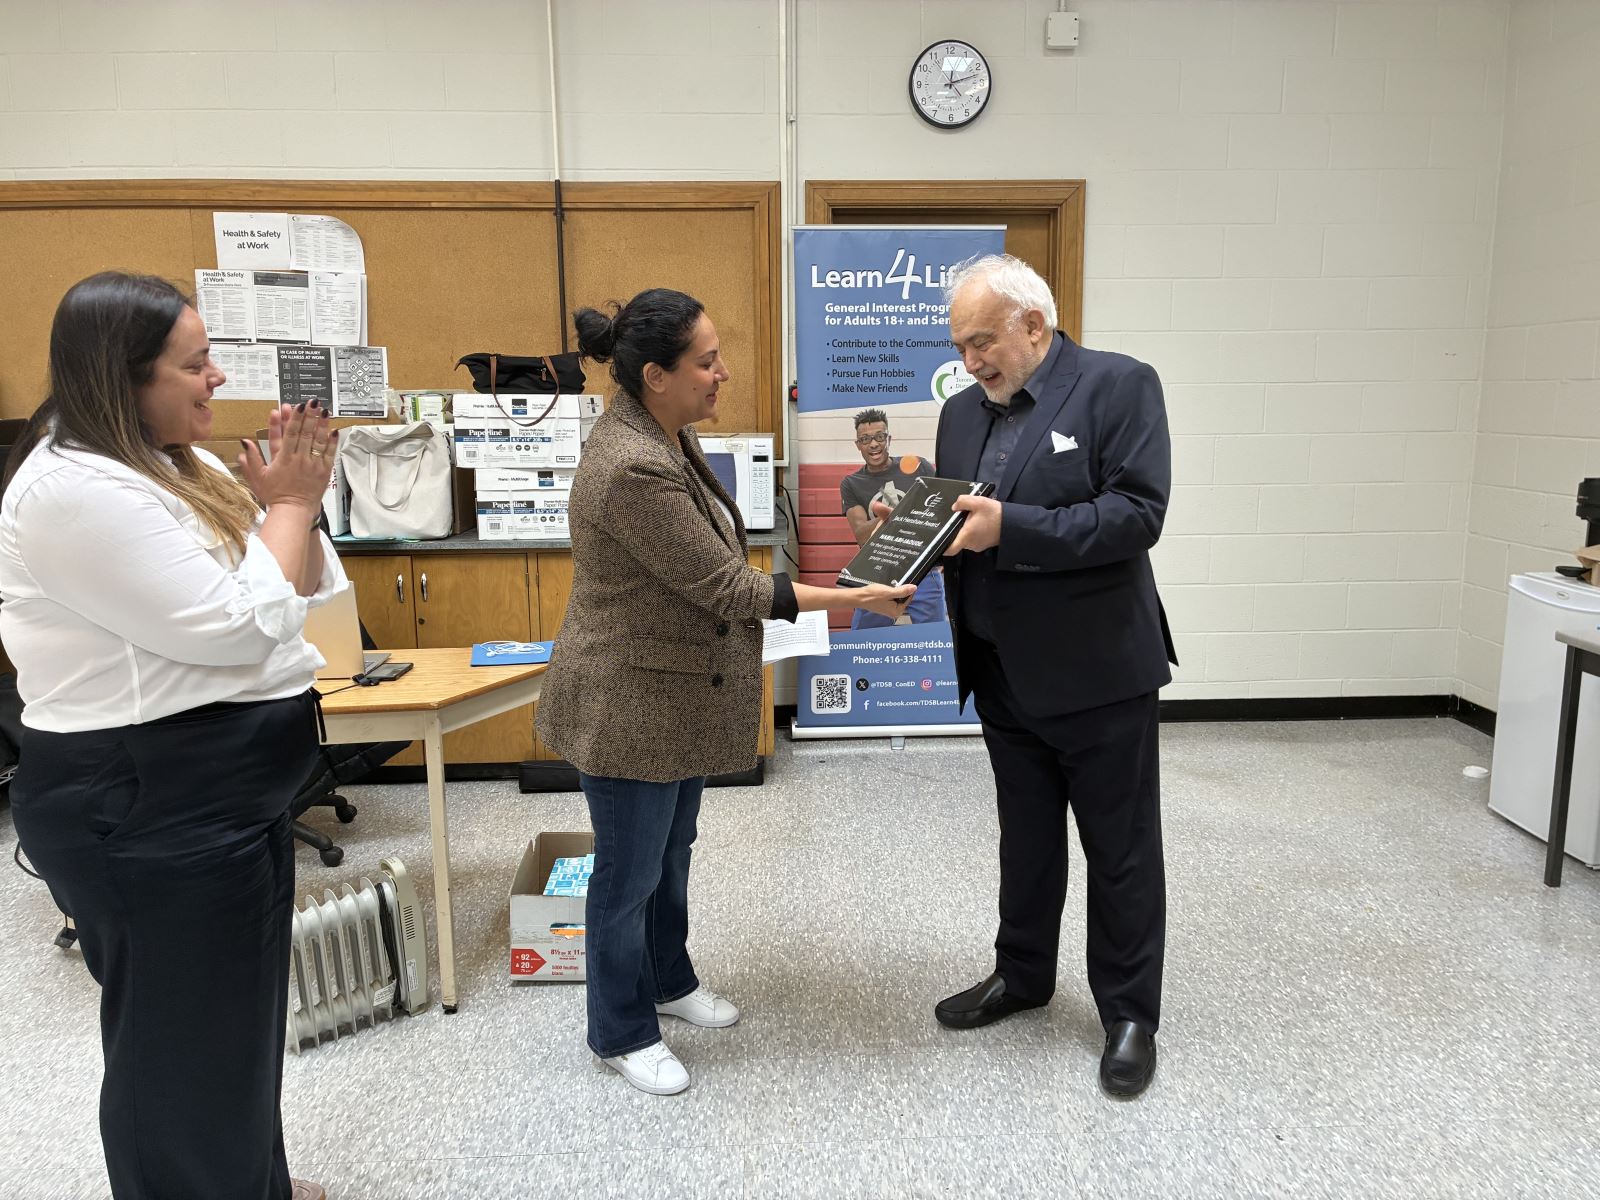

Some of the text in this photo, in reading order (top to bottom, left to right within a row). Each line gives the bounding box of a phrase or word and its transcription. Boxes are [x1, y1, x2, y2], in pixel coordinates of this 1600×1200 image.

[918, 64, 928, 72] 10
[980, 79, 984, 87] 3
[975, 96, 980, 104] 4
[222, 230, 281, 240] Health & Safety
[247, 242, 269, 250] Work
[811, 248, 957, 300] Learn4Lif
[825, 302, 951, 315] General Interest Progr
[825, 315, 951, 325] for Adults 18+ and Sen
[832, 339, 876, 348] Contribute
[889, 339, 903, 348] the
[906, 339, 954, 349] Community
[832, 353, 900, 363] Learn New Skills
[832, 369, 914, 378] Pursue Fun Hobbies
[832, 384, 908, 393] Make New Friends
[853, 655, 942, 664] Phone: 416-338-4111
[877, 699, 961, 707] facebook.com/TDSBLearn4L
